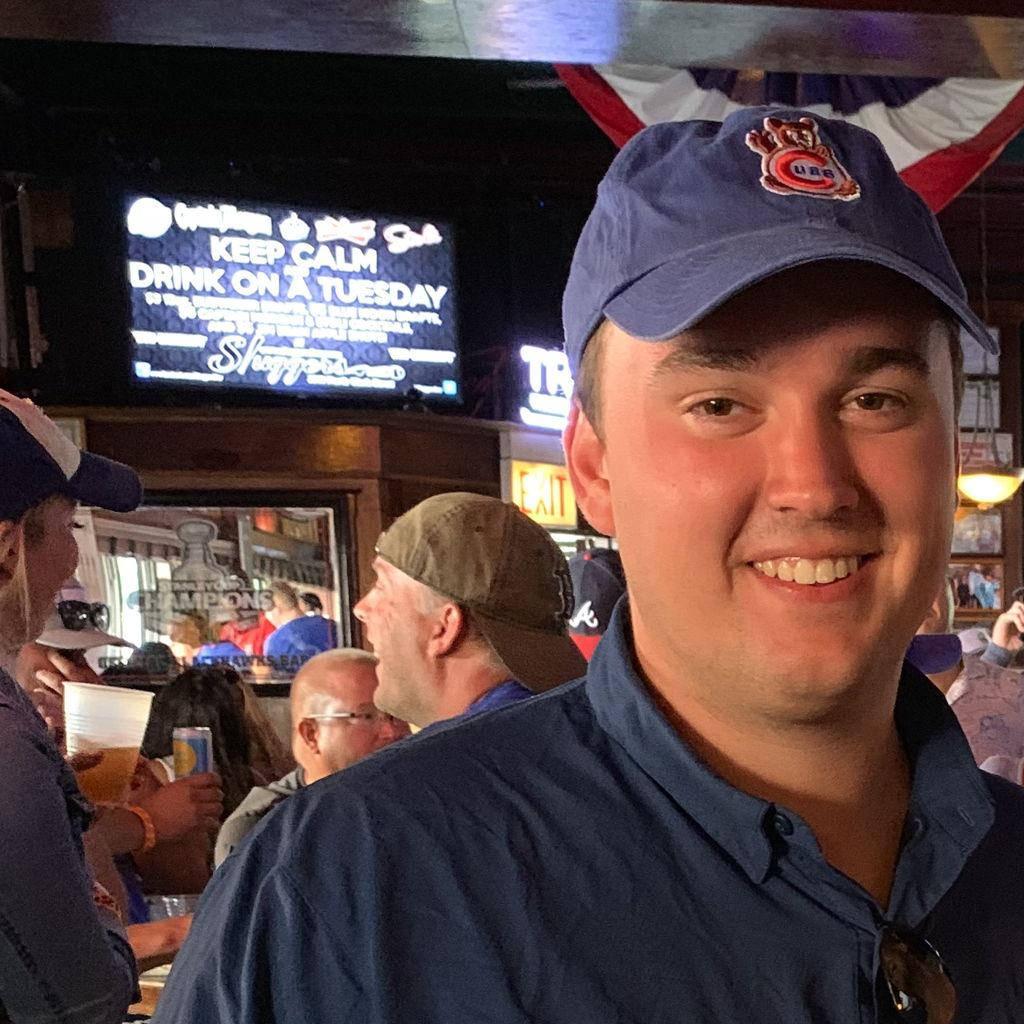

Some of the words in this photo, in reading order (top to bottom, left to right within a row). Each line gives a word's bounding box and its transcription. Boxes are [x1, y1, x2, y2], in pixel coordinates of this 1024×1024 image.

[209, 235, 286, 266] KEEP
[291, 243, 378, 274] CALM
[128, 260, 225, 293] DRINK
[231, 269, 281, 298] ON
[317, 275, 448, 310] TUESDAY
[519, 470, 567, 518] EXIT
